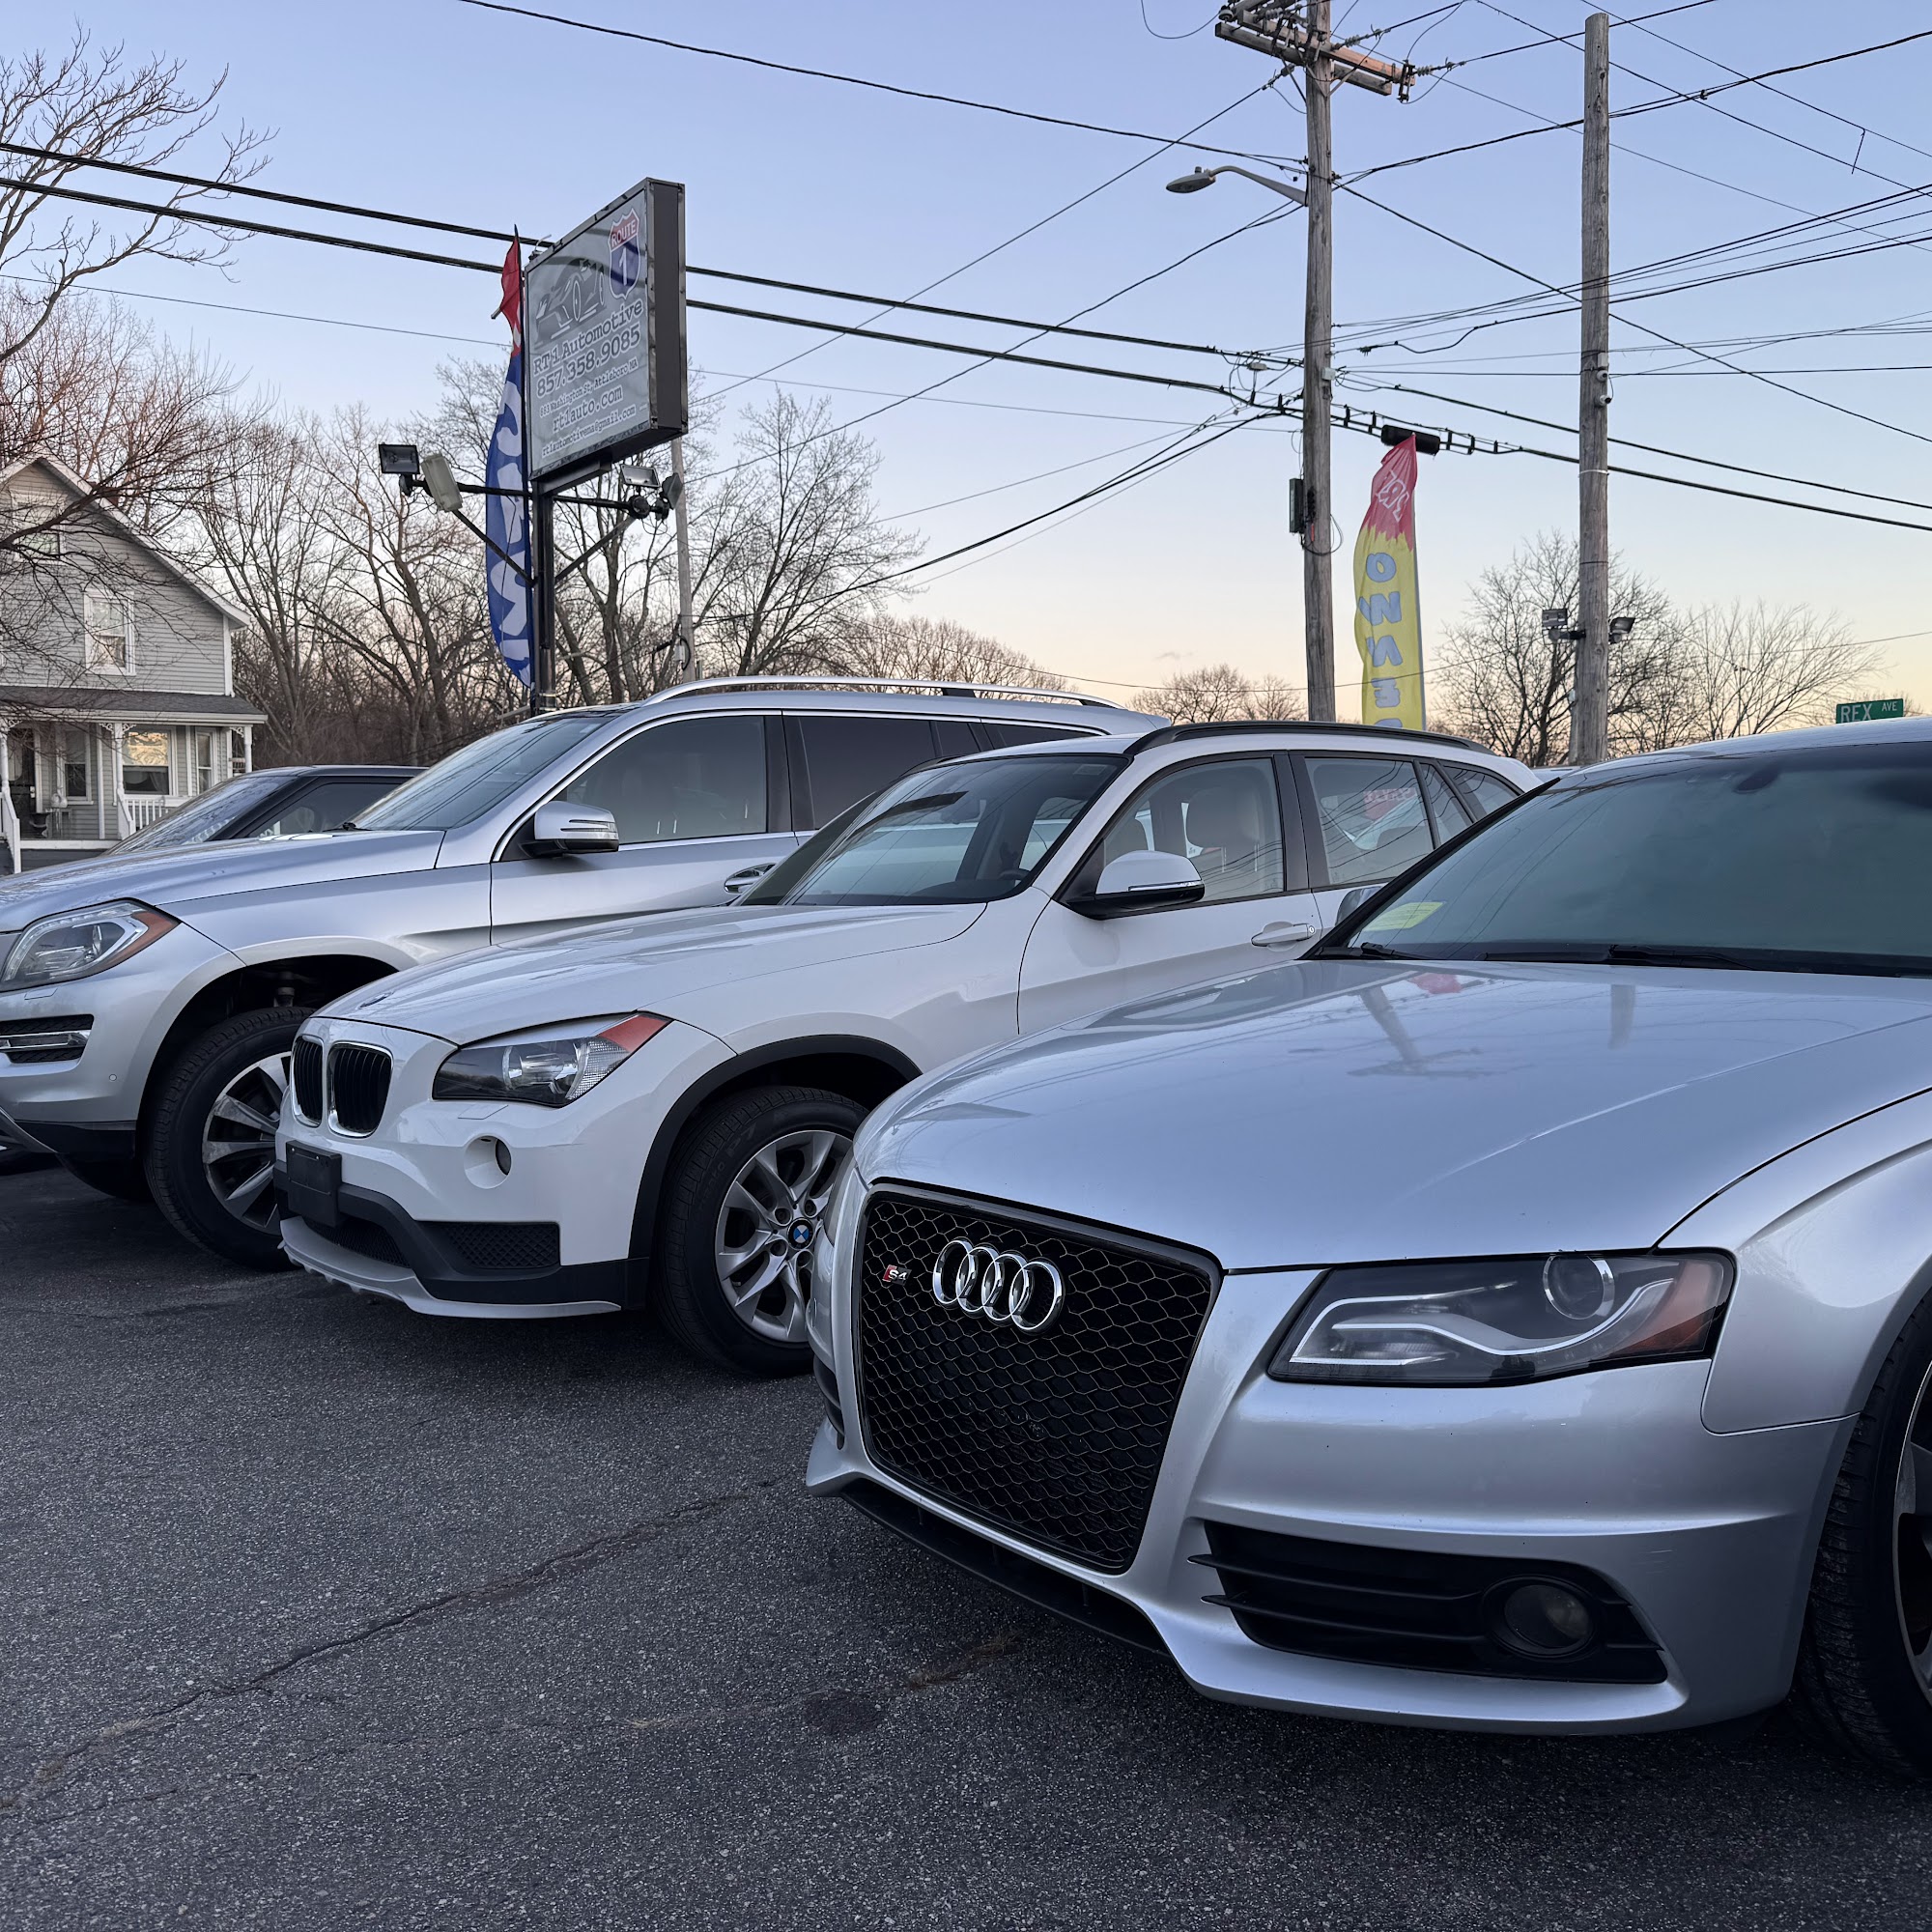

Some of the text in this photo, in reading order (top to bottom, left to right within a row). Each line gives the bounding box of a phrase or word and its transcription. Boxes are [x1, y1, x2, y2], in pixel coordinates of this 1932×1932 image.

[611, 219, 637, 248] ROUTE
[618, 246, 628, 287] 1
[533, 298, 643, 377] RT 1 Automotive
[537, 321, 641, 398] 857.358.9085
[593, 363, 628, 389] Attleboro
[628, 357, 639, 372] MA
[553, 385, 623, 433] rt1auto.com
[1840, 701, 1897, 724] REX AVE
[889, 1269, 908, 1281] S4
